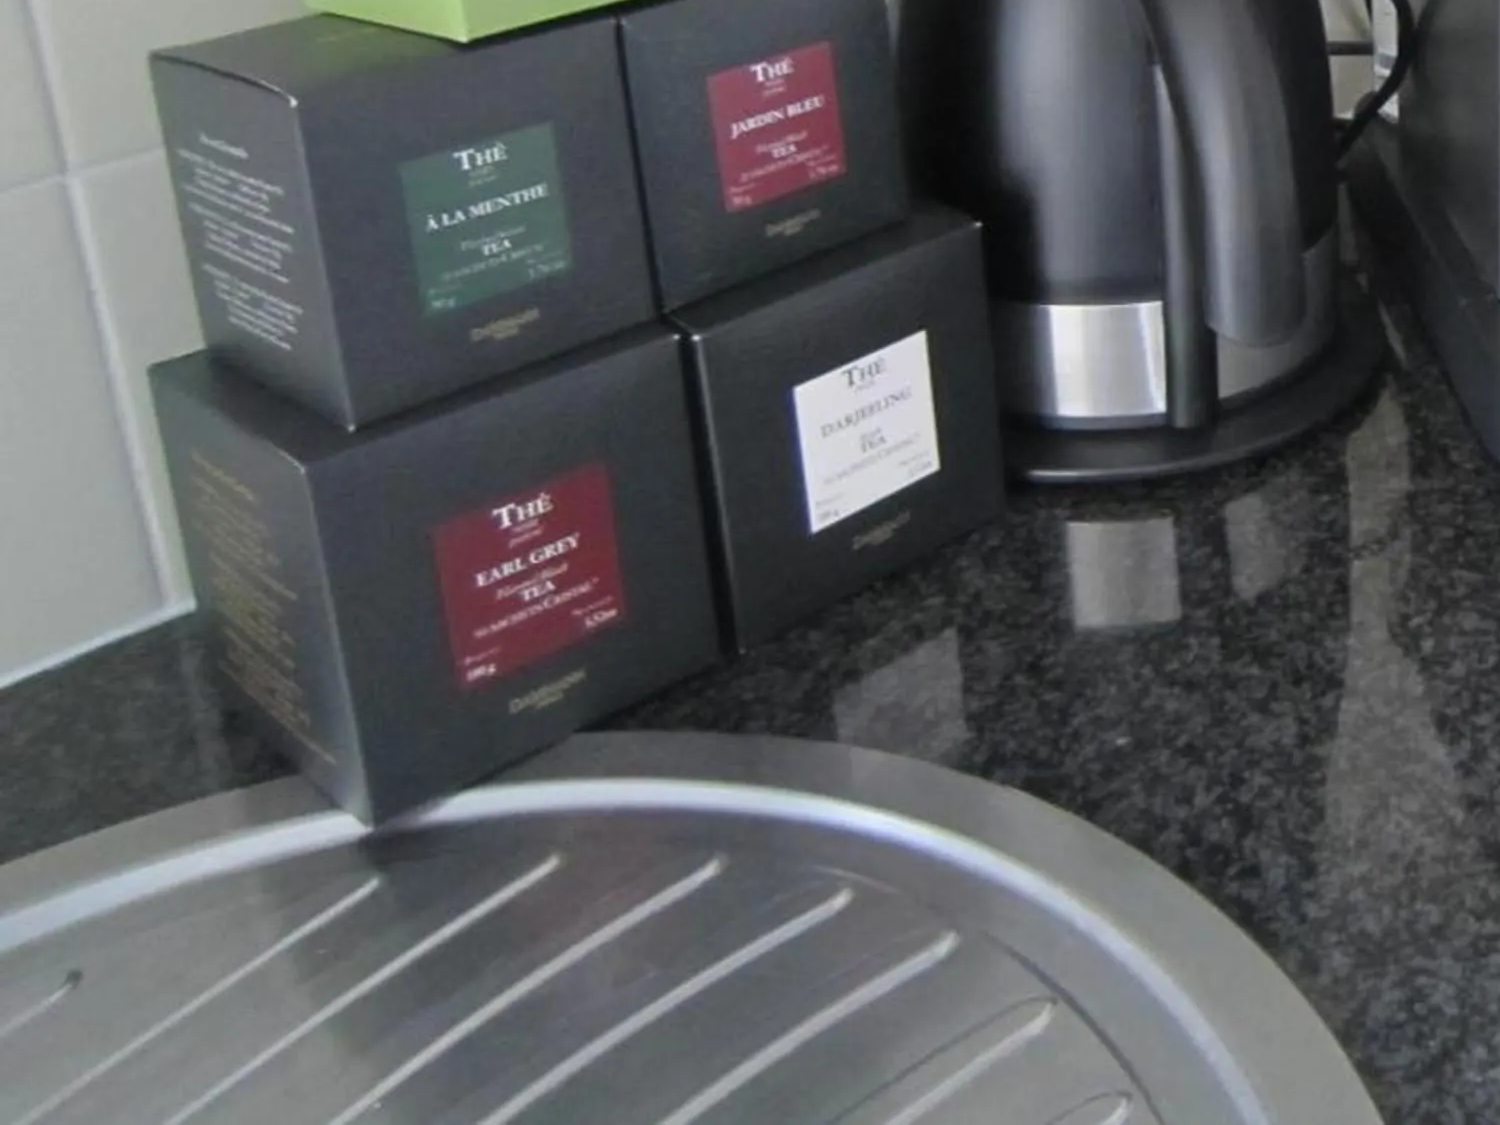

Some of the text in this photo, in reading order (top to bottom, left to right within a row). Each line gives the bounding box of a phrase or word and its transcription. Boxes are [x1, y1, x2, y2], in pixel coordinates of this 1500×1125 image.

[731, 95, 825, 139] JARDIN BLEU
[441, 209, 466, 227] LA
[467, 182, 548, 219] MENTHE
[481, 239, 512, 256] TEA
[820, 386, 912, 438] DARJEELING
[475, 557, 528, 588] EARL
[529, 533, 580, 564] GREY
[520, 580, 557, 602] TEA
